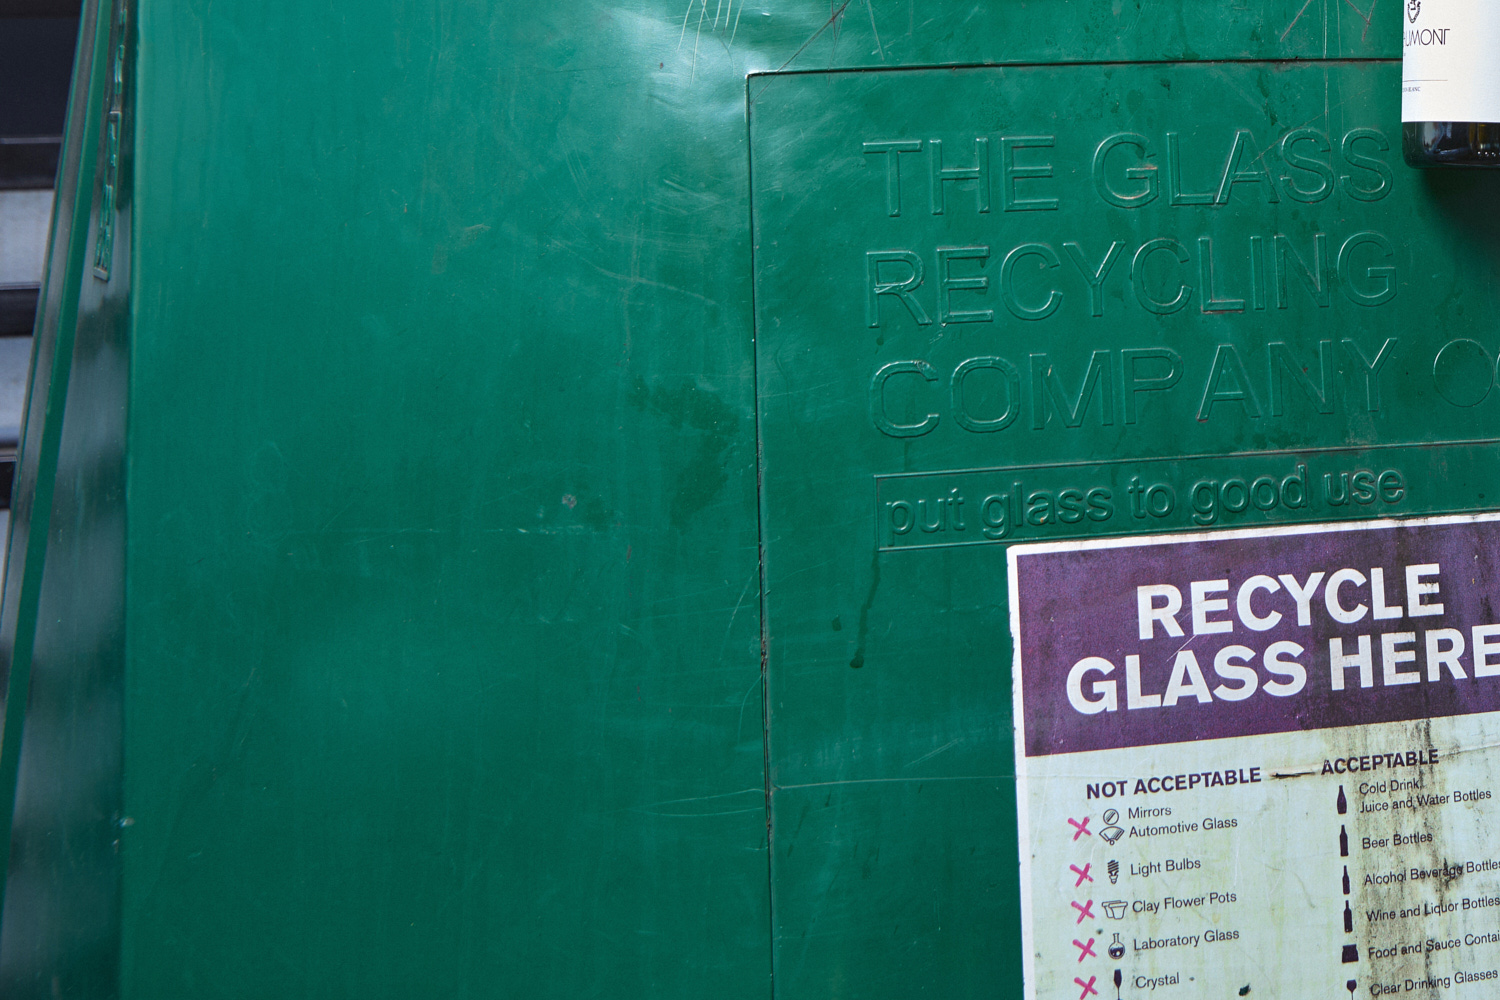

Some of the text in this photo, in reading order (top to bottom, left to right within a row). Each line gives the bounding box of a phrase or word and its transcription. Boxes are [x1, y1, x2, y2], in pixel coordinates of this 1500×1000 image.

[862, 127, 1395, 217] THE GLASS
[865, 230, 1397, 328] RECYCLING
[869, 336, 1397, 438] COMPANY
[886, 464, 1407, 547] put glass to good use
[1137, 563, 1445, 640] RECYCLE
[1065, 640, 1309, 716] GLASS
[1321, 749, 1440, 776] ACCEPTABLE
[1086, 767, 1262, 800] NOT ACCEPTABLE
[1359, 780, 1387, 795] Cold
[1128, 806, 1172, 820] Mirrors
[1359, 789, 1492, 813] Juice and Water Bottles
[1129, 817, 1238, 838] Automotive Glass
[1362, 832, 1433, 850] Beer Bottles
[1130, 858, 1201, 878] Light Bulbs
[1364, 869, 1407, 886] Alcohol
[1410, 863, 1464, 882] Beverage
[1132, 891, 1237, 915] Clay Flower Pots
[1366, 896, 1500, 922] Wine and Liquor Bottles
[1133, 929, 1240, 951] Laboratory Glass
[1368, 944, 1398, 960] Food
[1401, 941, 1422, 955] and
[1425, 938, 1461, 952] Sauce
[1135, 972, 1180, 990] Crystal
[1370, 969, 1499, 997] Clear Drinking Glasses
